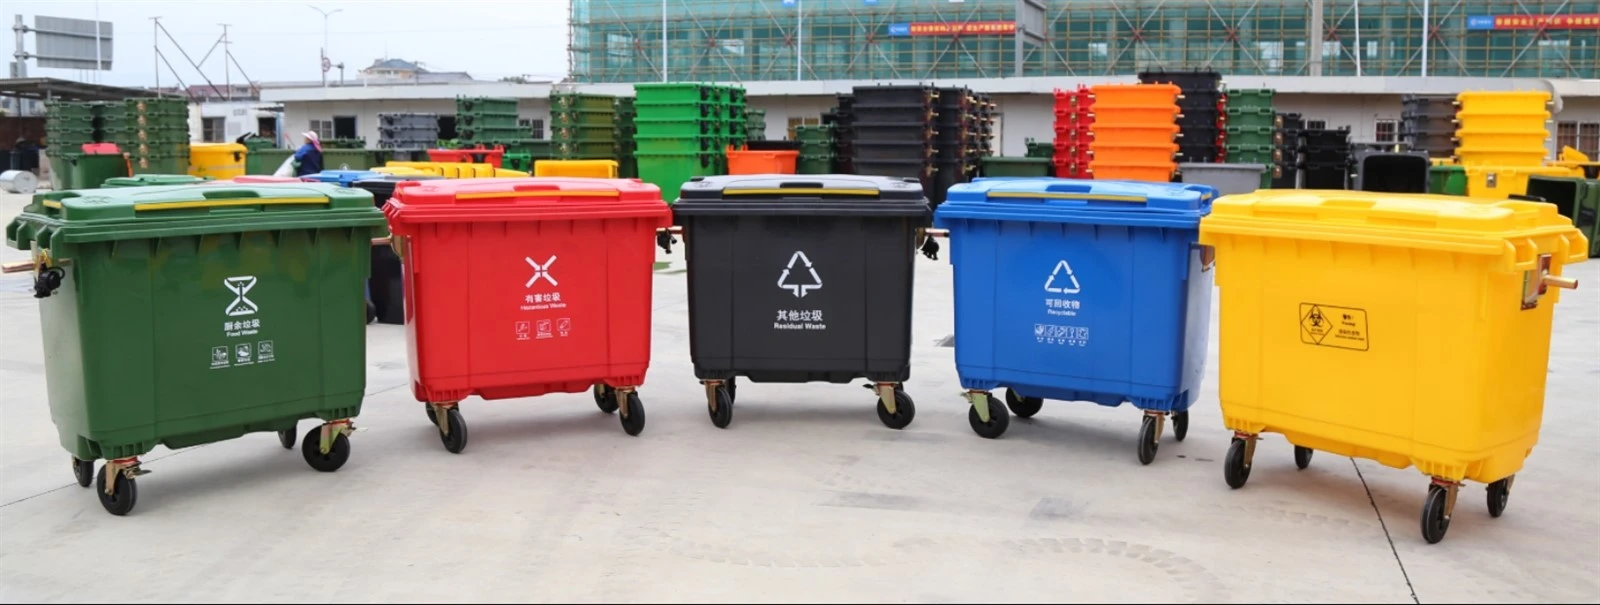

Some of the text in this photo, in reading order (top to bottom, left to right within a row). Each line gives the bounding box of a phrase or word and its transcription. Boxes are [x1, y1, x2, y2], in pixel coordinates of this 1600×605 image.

[525, 292, 561, 303] 有害垃圾
[1045, 298, 1080, 310] 可回收物
[776, 309, 823, 321] 其他垃圾
